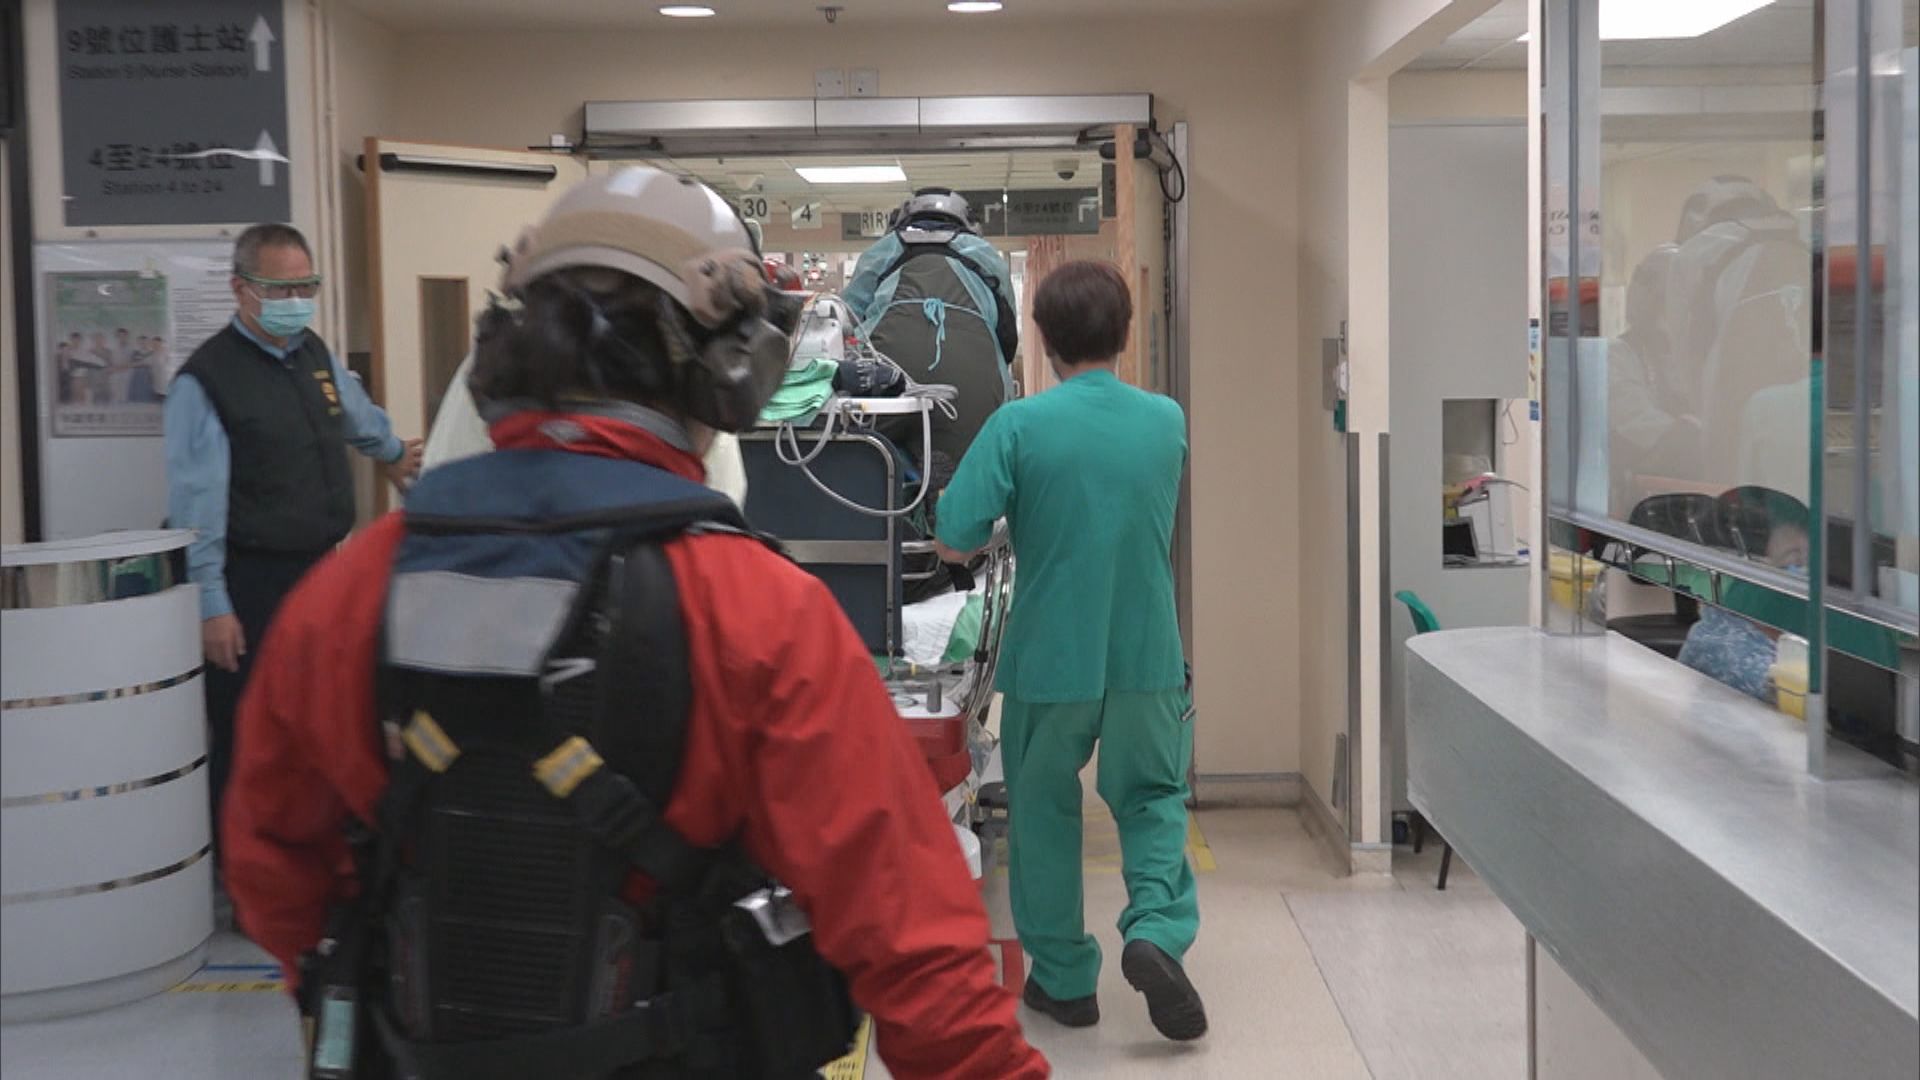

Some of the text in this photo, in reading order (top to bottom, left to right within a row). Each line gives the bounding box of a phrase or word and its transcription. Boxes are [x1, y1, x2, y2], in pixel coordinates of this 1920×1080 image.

[66, 23, 247, 54] 9號位護士站
[743, 198, 768, 219] 30
[800, 204, 812, 222] 4
